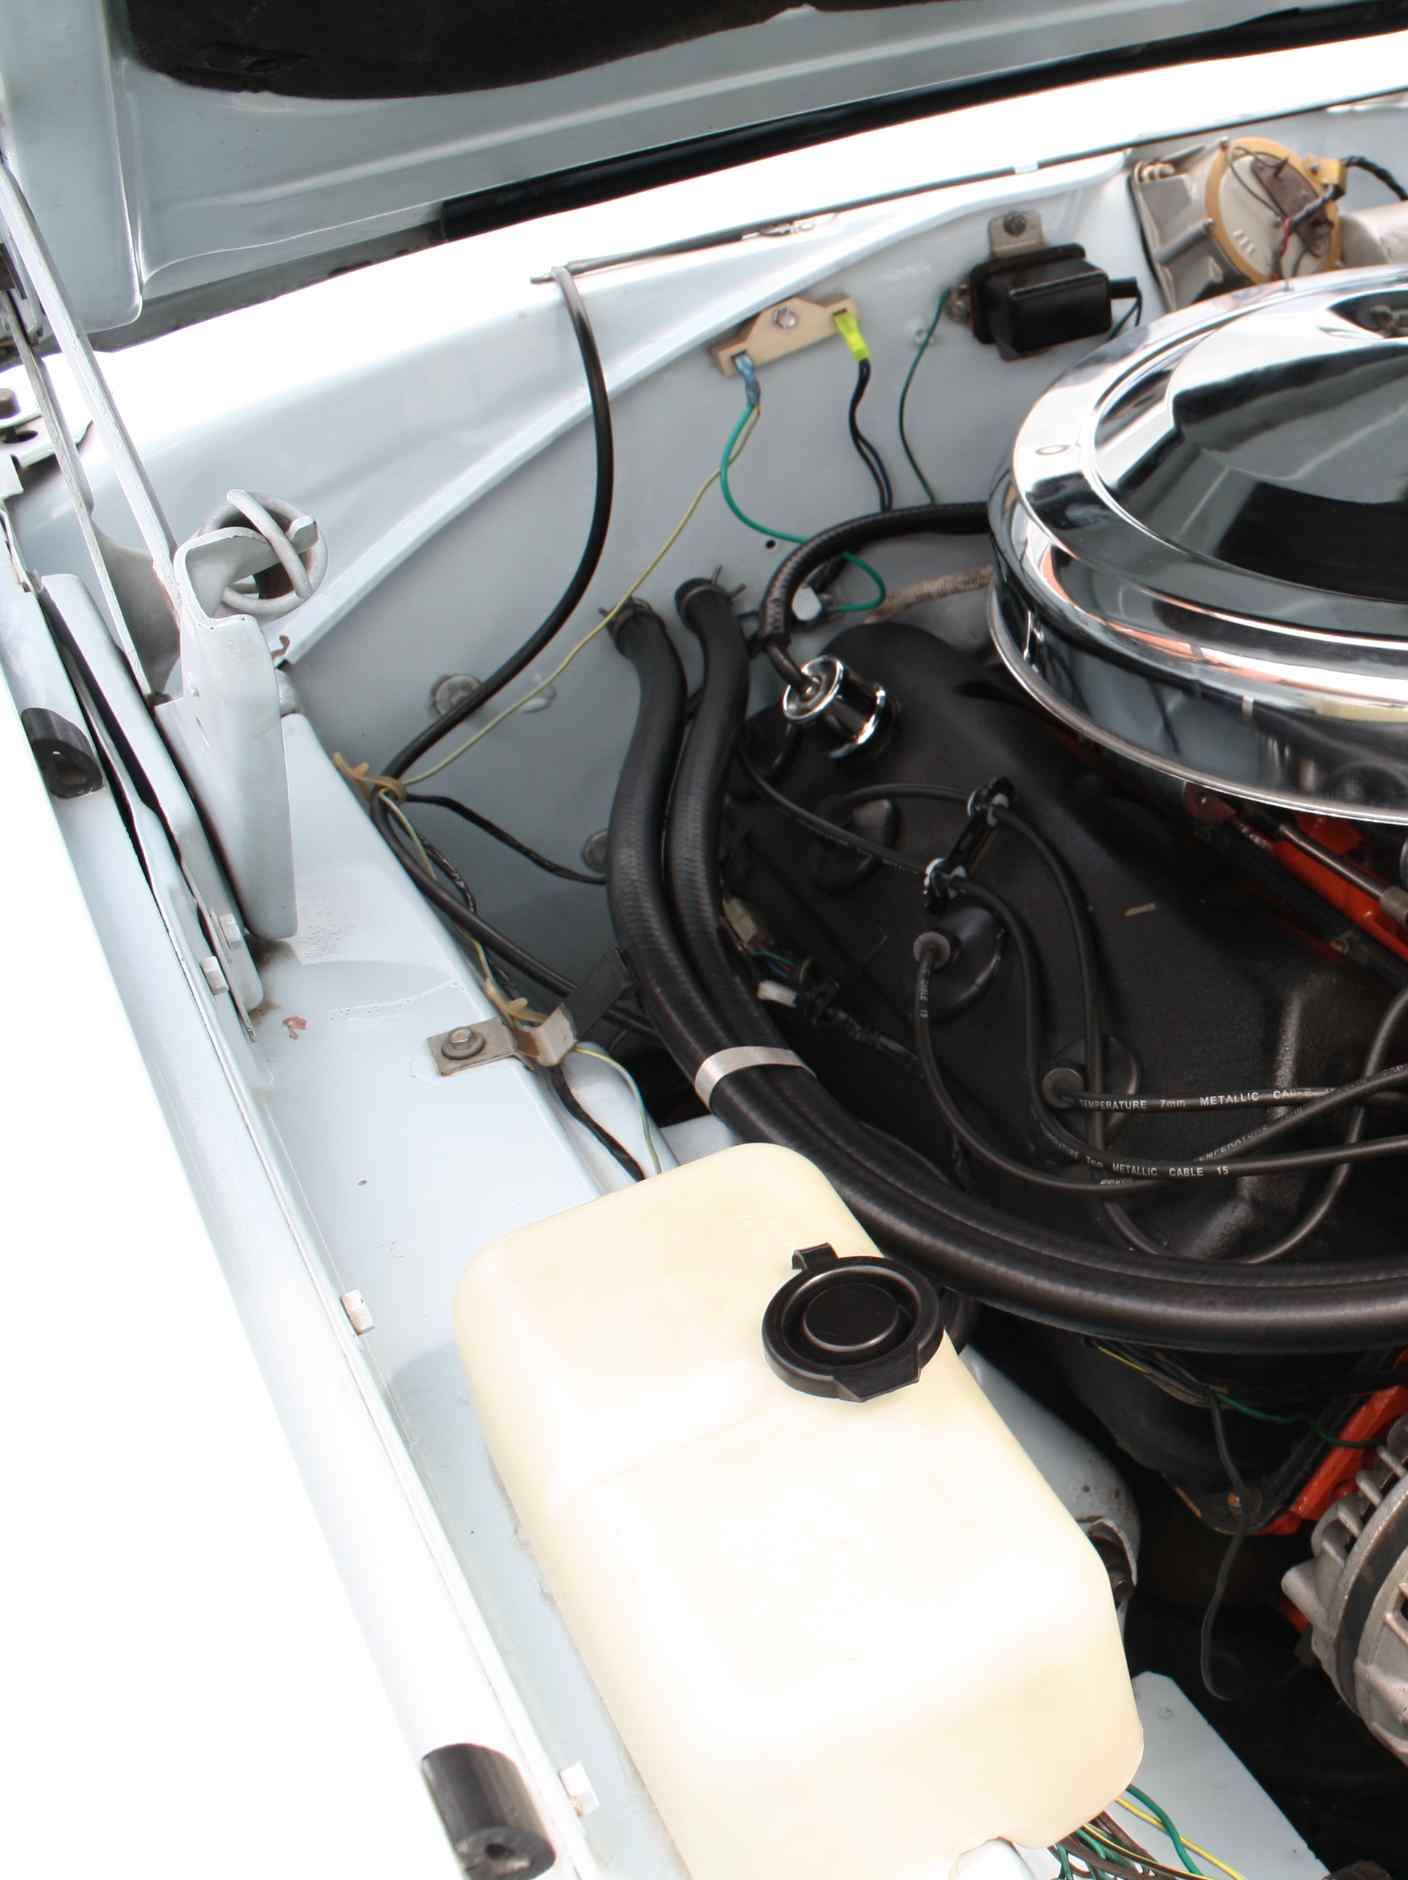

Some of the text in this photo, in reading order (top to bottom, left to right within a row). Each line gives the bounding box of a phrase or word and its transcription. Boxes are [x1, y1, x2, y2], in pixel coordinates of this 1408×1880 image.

[1200, 1090, 1260, 1107] METALLIC
[1112, 1162, 1159, 1178] METALLIC
[1168, 1166, 1205, 1177] CABLE
